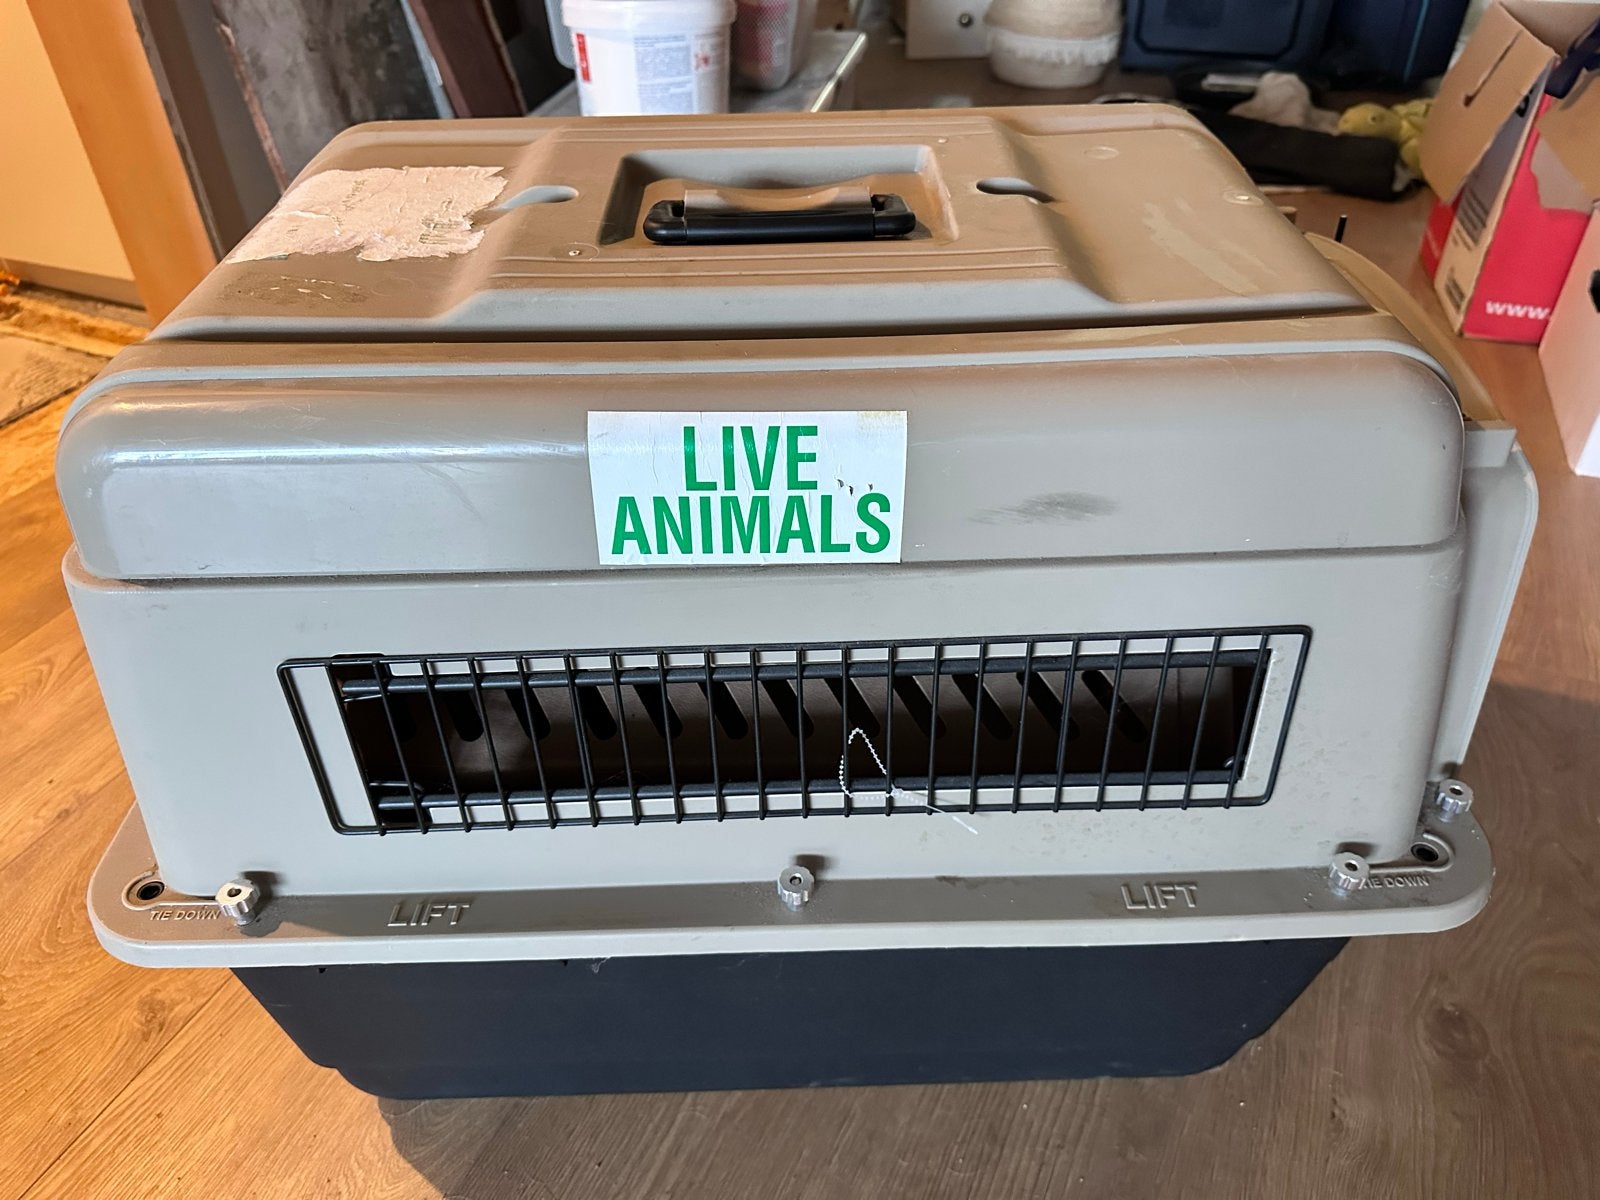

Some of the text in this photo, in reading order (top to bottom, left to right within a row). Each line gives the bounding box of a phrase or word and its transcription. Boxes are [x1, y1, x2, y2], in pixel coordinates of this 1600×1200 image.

[683, 425, 818, 491] LIVE
[611, 493, 891, 555] ANIMALS
[1383, 876, 1430, 888] DOWN
[1120, 883, 1198, 909] LIFT
[149, 910, 221, 921] TIE DOWN
[387, 903, 471, 927] LIFT
